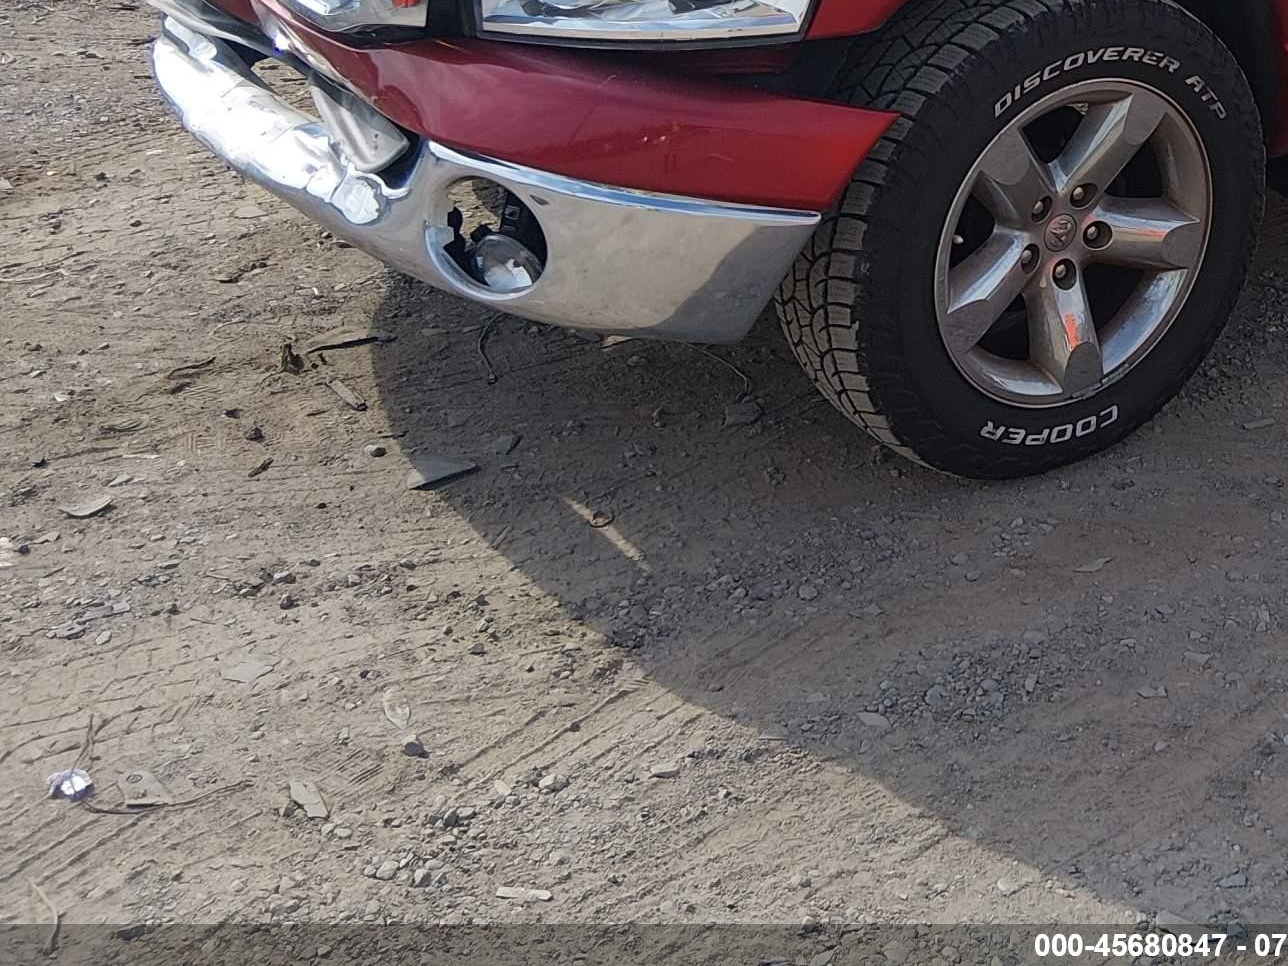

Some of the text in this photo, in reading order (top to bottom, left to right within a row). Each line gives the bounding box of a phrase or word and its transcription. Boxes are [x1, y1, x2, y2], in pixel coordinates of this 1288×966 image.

[994, 46, 1227, 120] DISCOVERER ATP
[980, 405, 1118, 445] COOPER
